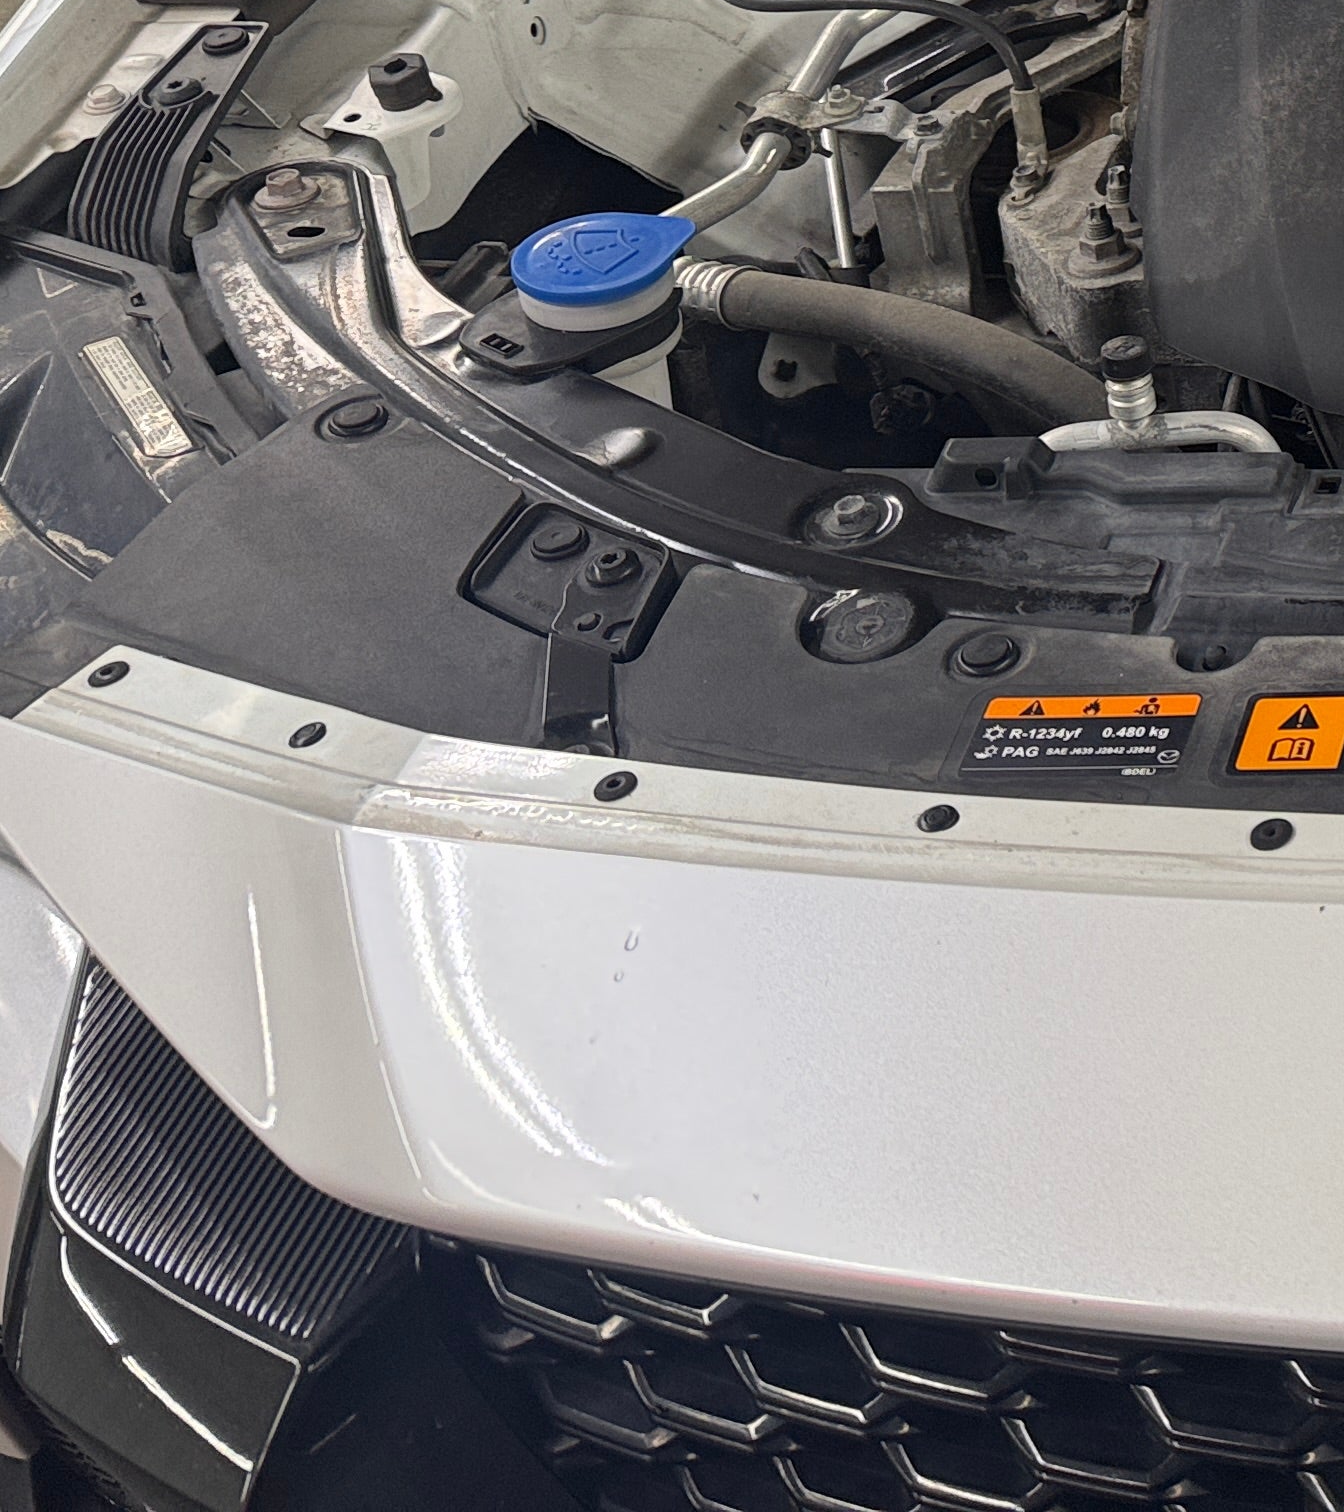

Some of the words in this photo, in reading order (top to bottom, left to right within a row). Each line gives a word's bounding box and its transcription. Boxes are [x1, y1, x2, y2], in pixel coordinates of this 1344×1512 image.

[1008, 727, 1083, 742] R-1234yf
[1102, 726, 1146, 739] 0.480
[1148, 725, 1170, 740] kg
[1001, 745, 1040, 759] PAG
[1045, 747, 1069, 756] SAE
